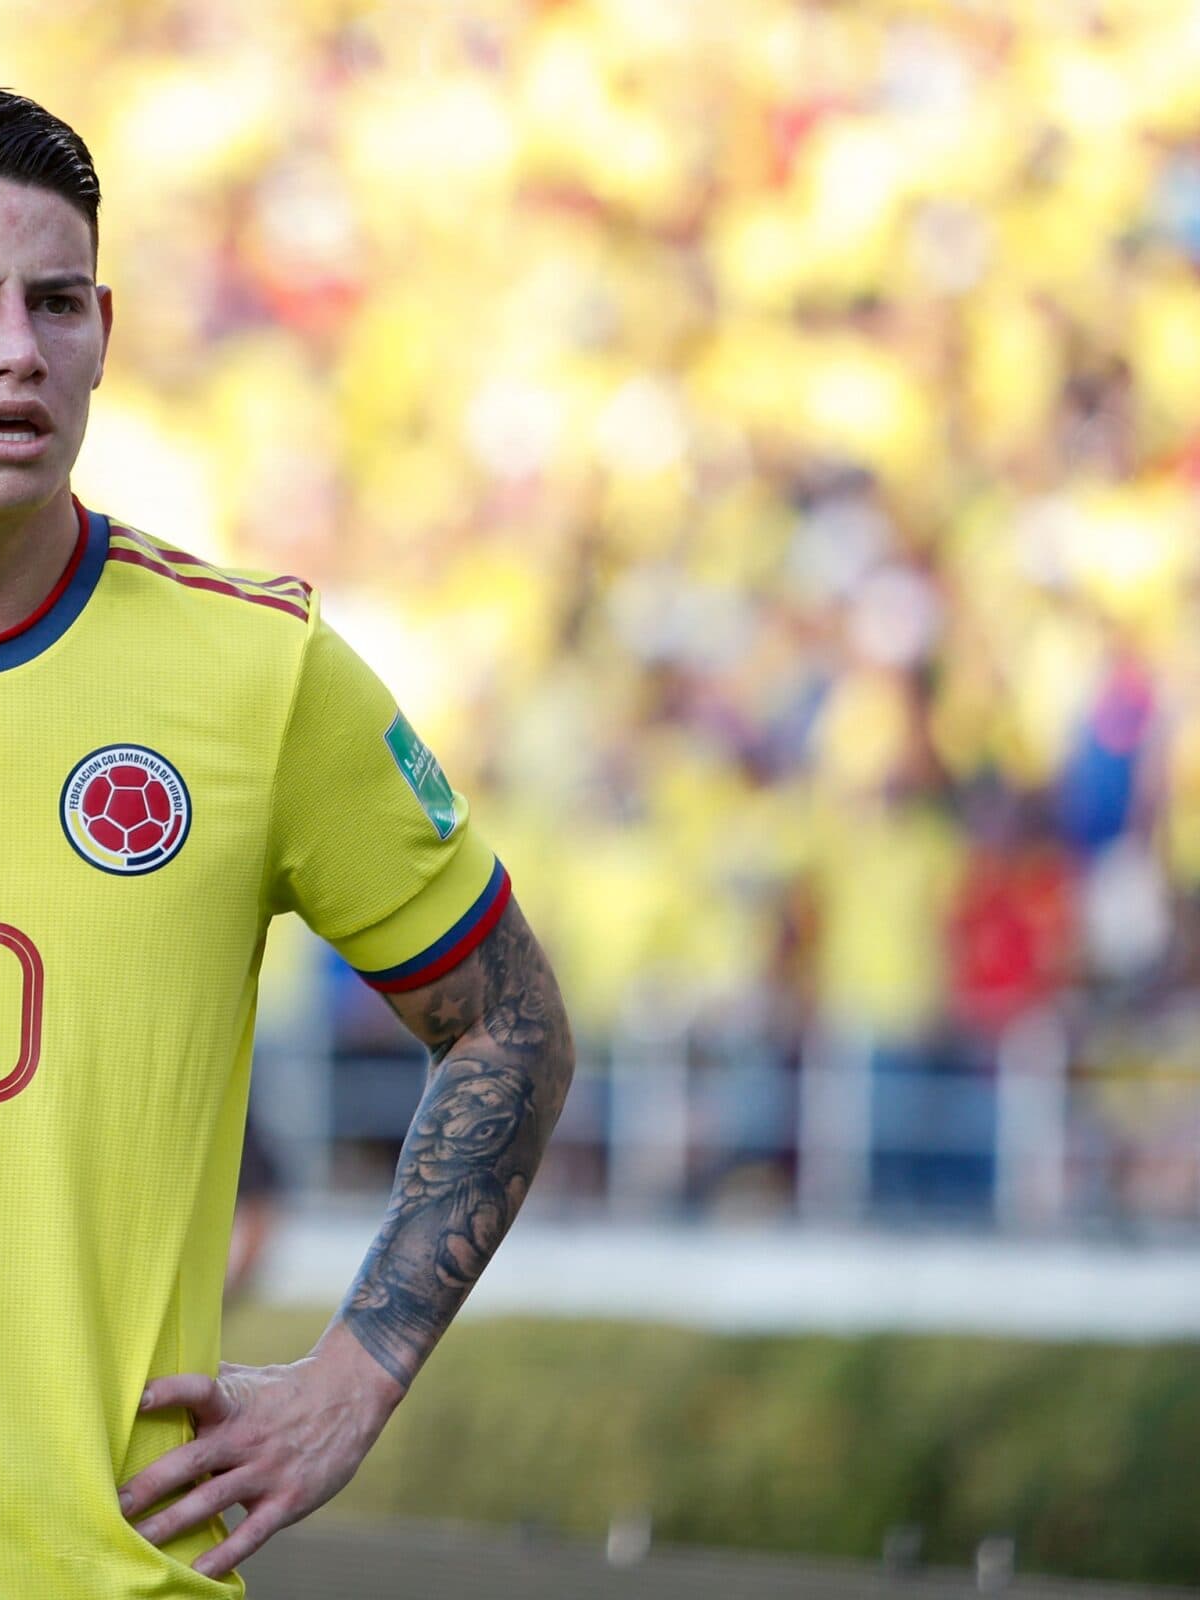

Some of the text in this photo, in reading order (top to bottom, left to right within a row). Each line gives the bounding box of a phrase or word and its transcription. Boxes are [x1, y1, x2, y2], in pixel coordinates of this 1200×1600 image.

[69, 752, 184, 813] FEDERACION COLOMBIANA DE FUTBOL
